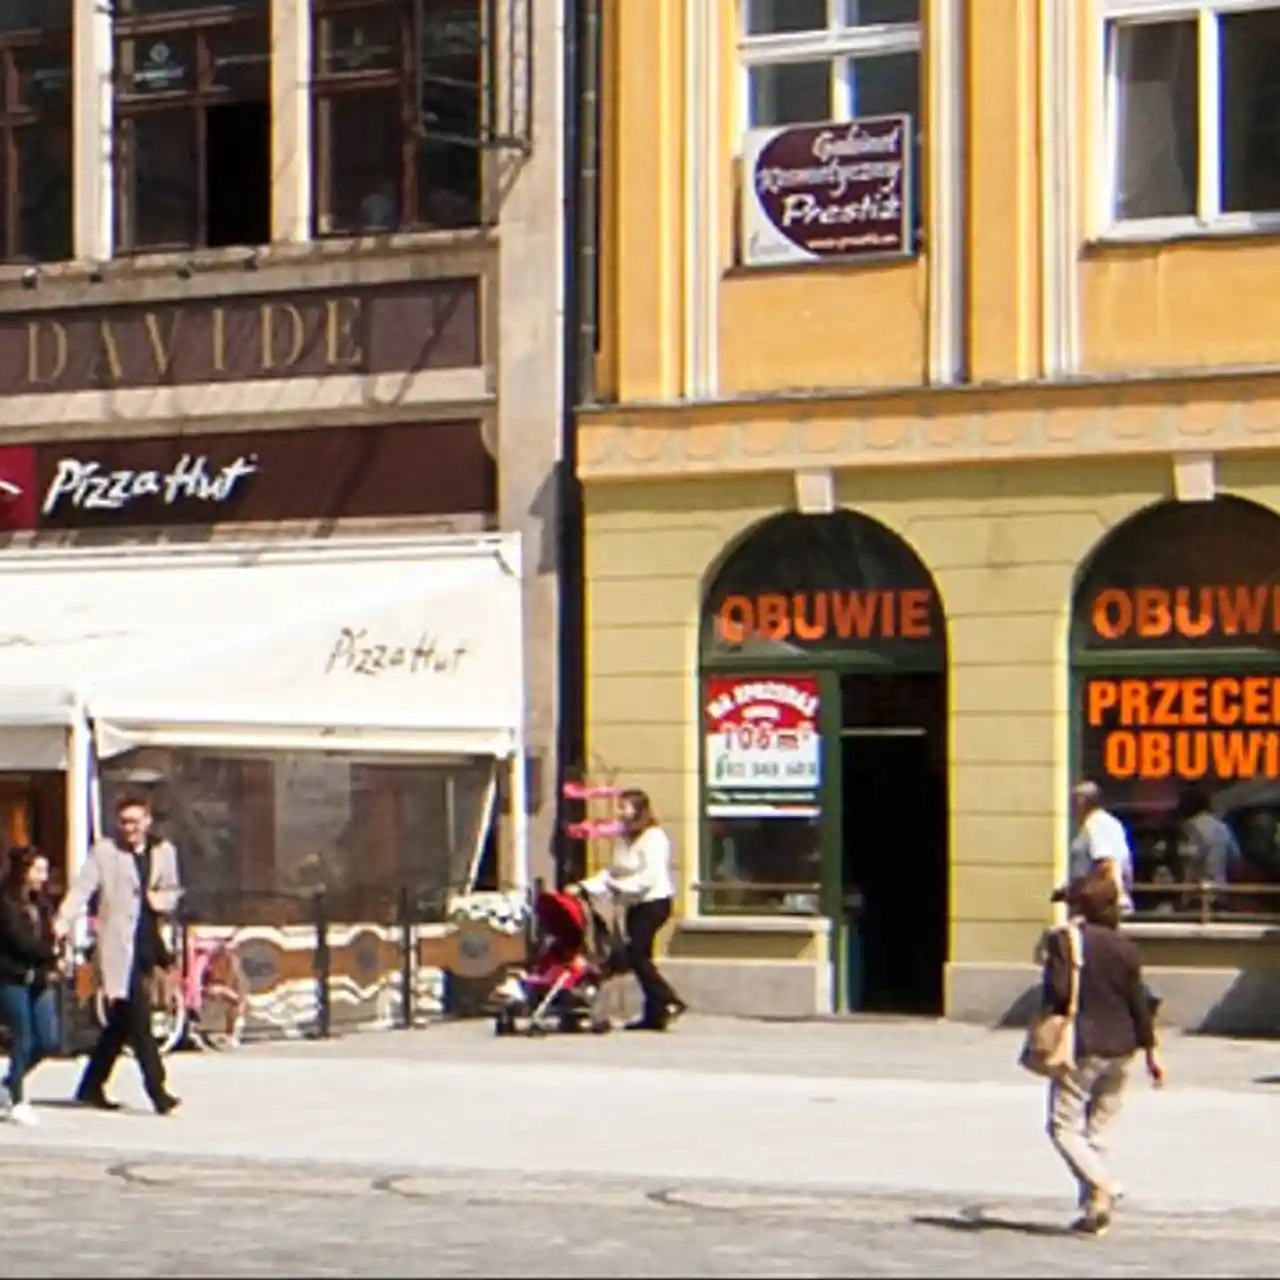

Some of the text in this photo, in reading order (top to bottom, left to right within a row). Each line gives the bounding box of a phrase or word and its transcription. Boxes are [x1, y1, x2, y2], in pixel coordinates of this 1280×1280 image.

[28, 297, 362, 382] DAVIDE
[42, 453, 257, 515] Pizza Hut
[720, 591, 932, 643] OBUWIE
[324, 626, 469, 676] Pizza Hut
[1088, 677, 1280, 727] PRZECE
[1104, 729, 1280, 780] OBUWI
